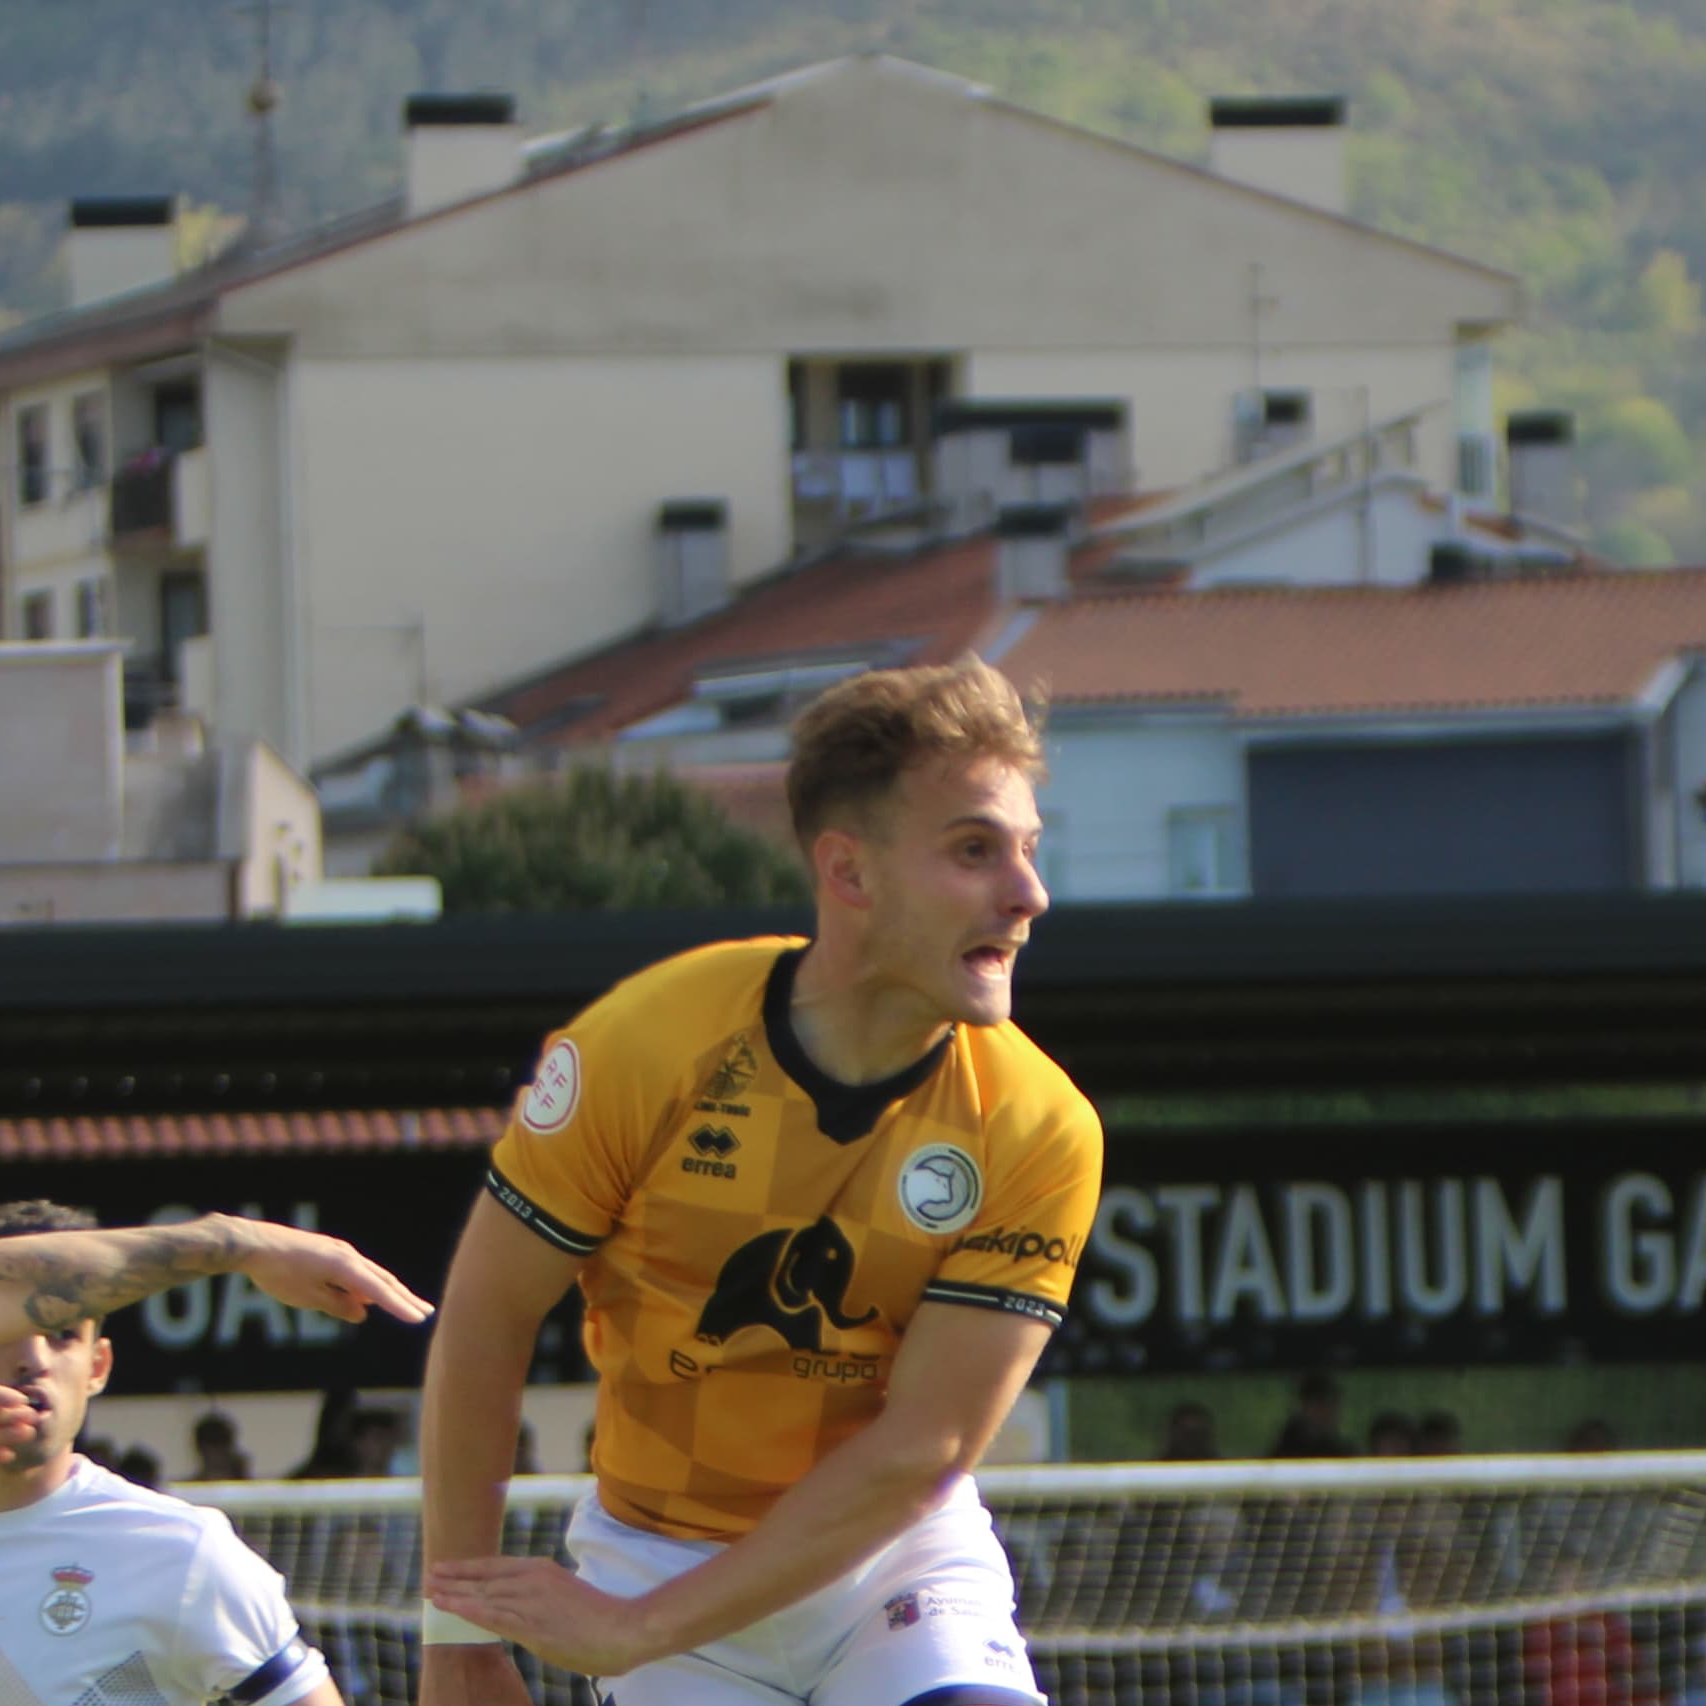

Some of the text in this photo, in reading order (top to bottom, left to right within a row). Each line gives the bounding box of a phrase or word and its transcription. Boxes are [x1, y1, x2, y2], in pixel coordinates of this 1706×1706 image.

[498, 1186, 534, 1220] 2013
[1091, 1176, 1567, 1324] STADIUM
[1003, 1296, 1045, 1317] 2023
[793, 1354, 879, 1383] grupo
